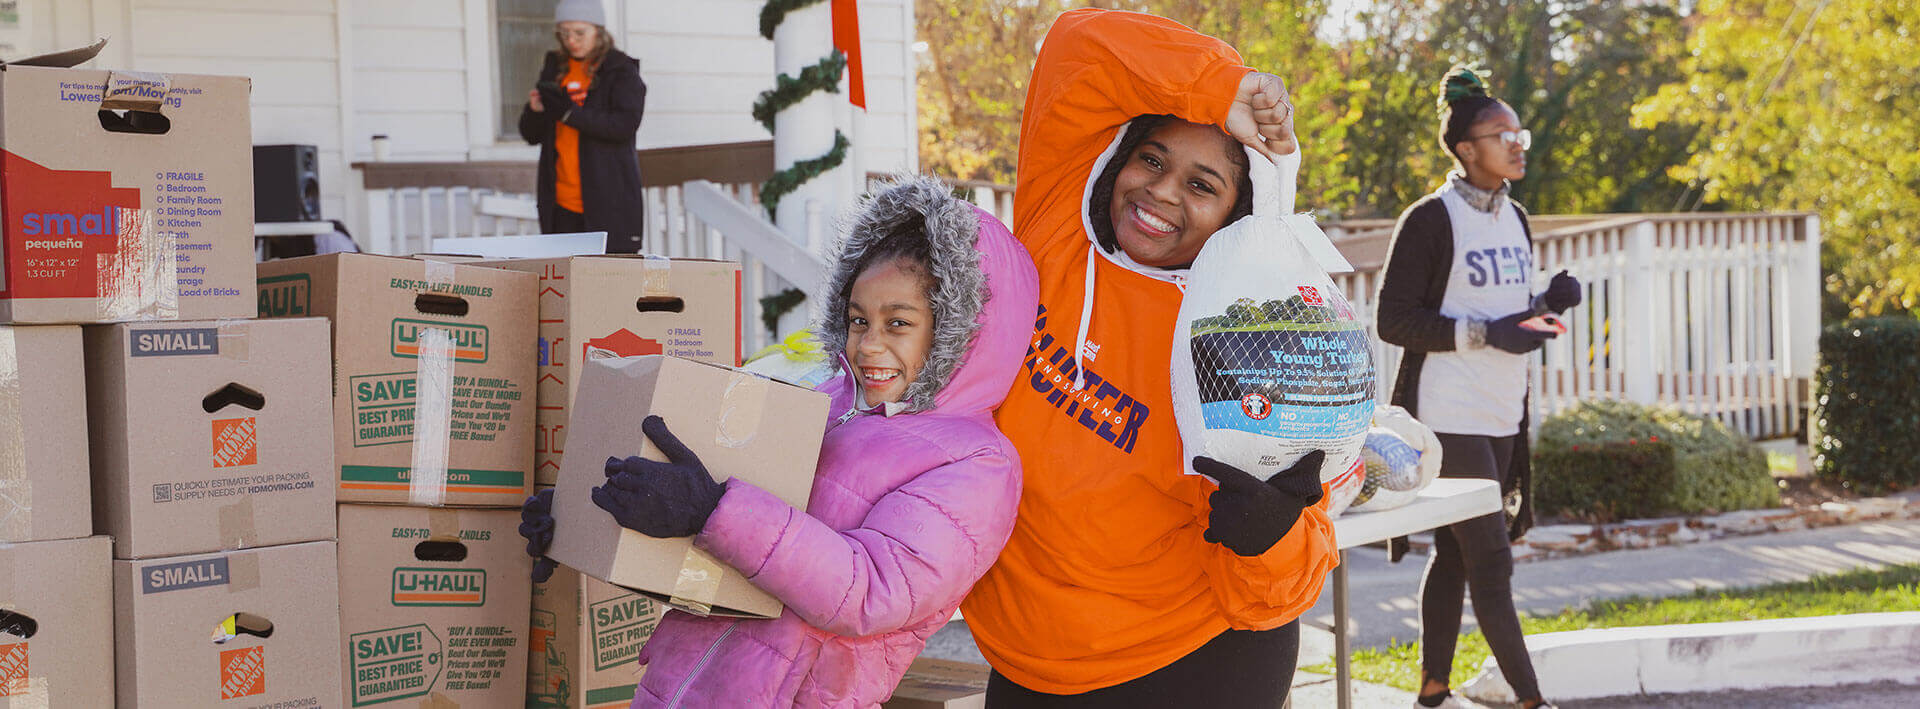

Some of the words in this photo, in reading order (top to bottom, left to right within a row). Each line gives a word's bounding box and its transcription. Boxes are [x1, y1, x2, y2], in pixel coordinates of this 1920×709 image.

[166, 172, 204, 180] FRAGILE
[166, 184, 206, 192] Bedroom
[167, 196, 196, 205] Family
[197, 196, 222, 204] Room
[167, 207, 195, 217] Dining
[197, 208, 222, 216] Room
[23, 206, 119, 235] small
[167, 219, 202, 227] Kitchen
[25, 238, 83, 250] pequeña
[175, 253, 191, 262] ttic
[27, 270, 38, 278] 1.3
[41, 270, 53, 278] CU
[55, 270, 66, 278] FT
[175, 265, 206, 274] aundry
[177, 277, 203, 286] arage
[179, 289, 201, 297] Load
[203, 288, 212, 296] of
[214, 288, 240, 296] Bricks
[452, 285, 493, 297] HANDLES
[258, 286, 303, 317] AUL
[674, 328, 701, 336] FRAGILE
[138, 333, 211, 351] SMALL
[1300, 337, 1347, 350] Whole
[674, 350, 695, 358] Family
[1270, 351, 1323, 367] Young
[1269, 368, 1282, 377] Up
[452, 376, 468, 386] BUY
[469, 377, 475, 386] A
[357, 380, 417, 403] SAVE
[452, 388, 472, 398] SAVE
[473, 389, 494, 398] EVEN
[496, 390, 522, 400] MORE!
[452, 399, 468, 408] Beat
[470, 400, 483, 408] Our
[485, 401, 511, 410] Bundle
[359, 410, 388, 425] BEST
[392, 408, 416, 423] PRI
[451, 409, 474, 418] Prices
[475, 411, 490, 420] and
[1281, 412, 1297, 420] NO
[450, 420, 466, 429] Give
[469, 421, 482, 430] You
[216, 423, 234, 444] THE
[360, 424, 414, 440] GUARANTE
[450, 431, 469, 440] FREE
[470, 432, 496, 441] Boxes!
[214, 417, 258, 466] HOME
[231, 436, 257, 465] DEPOT
[174, 480, 209, 492] QUICKLY
[212, 477, 249, 488] ESTIMATE
[250, 474, 274, 485] YOUR
[276, 471, 309, 482] PACKING
[174, 490, 206, 501] SUPPLY
[208, 487, 235, 498] NEEDS
[236, 486, 248, 496] AT
[248, 480, 314, 494] HDMOVING.COM
[458, 531, 491, 541] NDLES
[150, 563, 222, 588] SMALL
[399, 574, 480, 592] U-HAUL
[596, 598, 655, 627] SAVE!
[466, 627, 473, 636] A
[599, 632, 624, 650] BEST
[627, 623, 655, 642] PRICE
[357, 631, 423, 660] SAVE!
[448, 638, 469, 648] SAVE
[470, 638, 490, 648] EVEN
[492, 638, 517, 647] MORE!
[448, 649, 465, 658] Beat
[466, 649, 479, 657] Our
[481, 649, 506, 658] Bundle
[601, 640, 642, 663] GUARANT
[0, 641, 31, 684] OME
[224, 654, 243, 675] THE
[447, 660, 470, 669] Prices
[471, 660, 486, 668] and
[222, 645, 265, 698] HOME
[358, 666, 389, 683] BEST
[390, 660, 423, 675] PRICE
[447, 670, 463, 679] Give
[464, 671, 478, 679] You
[239, 663, 264, 696] DEPOT
[446, 681, 465, 690] FREE
[466, 680, 491, 690] Boxes!
[283, 697, 317, 709] PACKING
